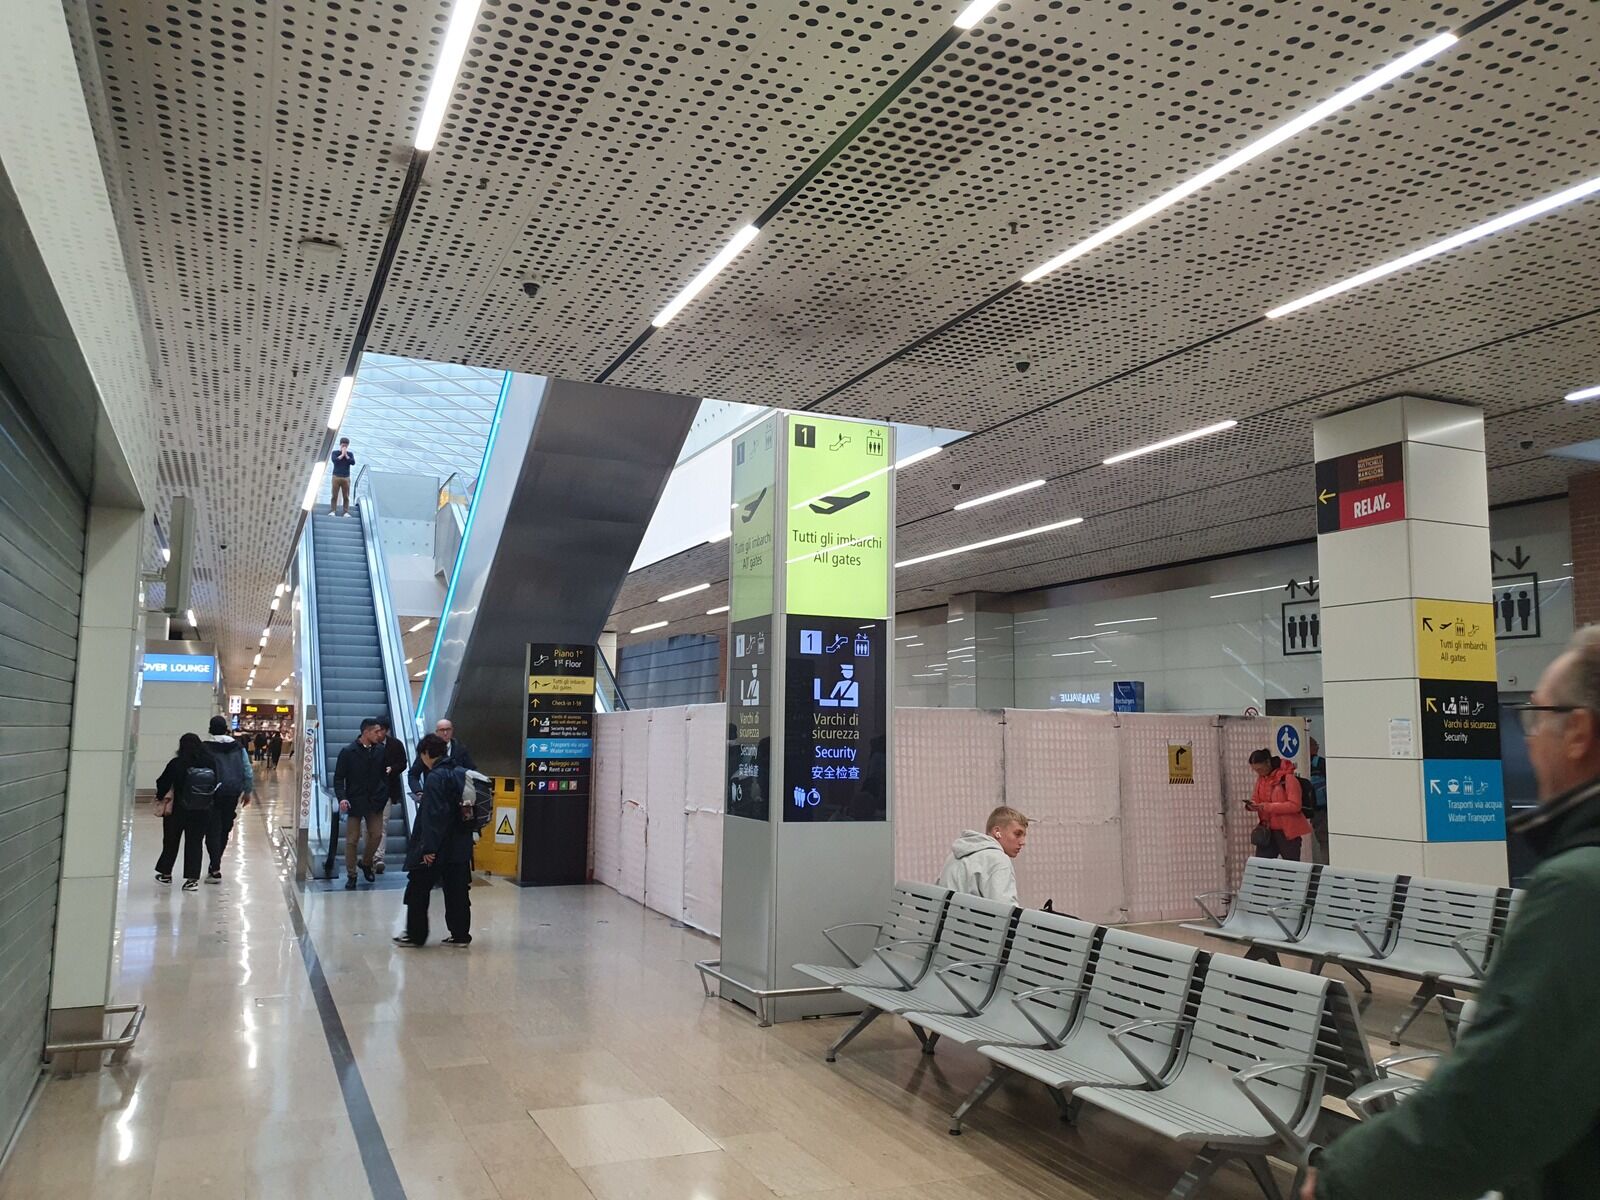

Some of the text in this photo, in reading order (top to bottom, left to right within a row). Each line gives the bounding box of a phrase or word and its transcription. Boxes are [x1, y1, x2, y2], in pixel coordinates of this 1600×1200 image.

[792, 529, 882, 549] Tutti gli imbarchi
[814, 551, 862, 567] All gates
[1440, 639, 1453, 648] Tutti
[1463, 641, 1488, 651] imbarchi
[554, 649, 574, 658] Piano
[1440, 653, 1467, 664] All gates
[170, 663, 210, 673] LOUNGE
[554, 659, 582, 668] 1st Floor
[740, 712, 759, 725] Varchi di
[813, 713, 859, 726] Varchi di
[1444, 719, 1497, 730] Varchi di sicurezza
[739, 728, 760, 738] sicurezza
[812, 727, 860, 740] sicurezza
[1444, 732, 1468, 743] Security
[740, 744, 758, 759] Security
[815, 745, 857, 761] Security
[811, 765, 861, 780] 安全检查
[538, 781, 546, 790] P
[1448, 800, 1503, 811] Trasporti via acqua
[1448, 813, 1496, 824] Water Transport
